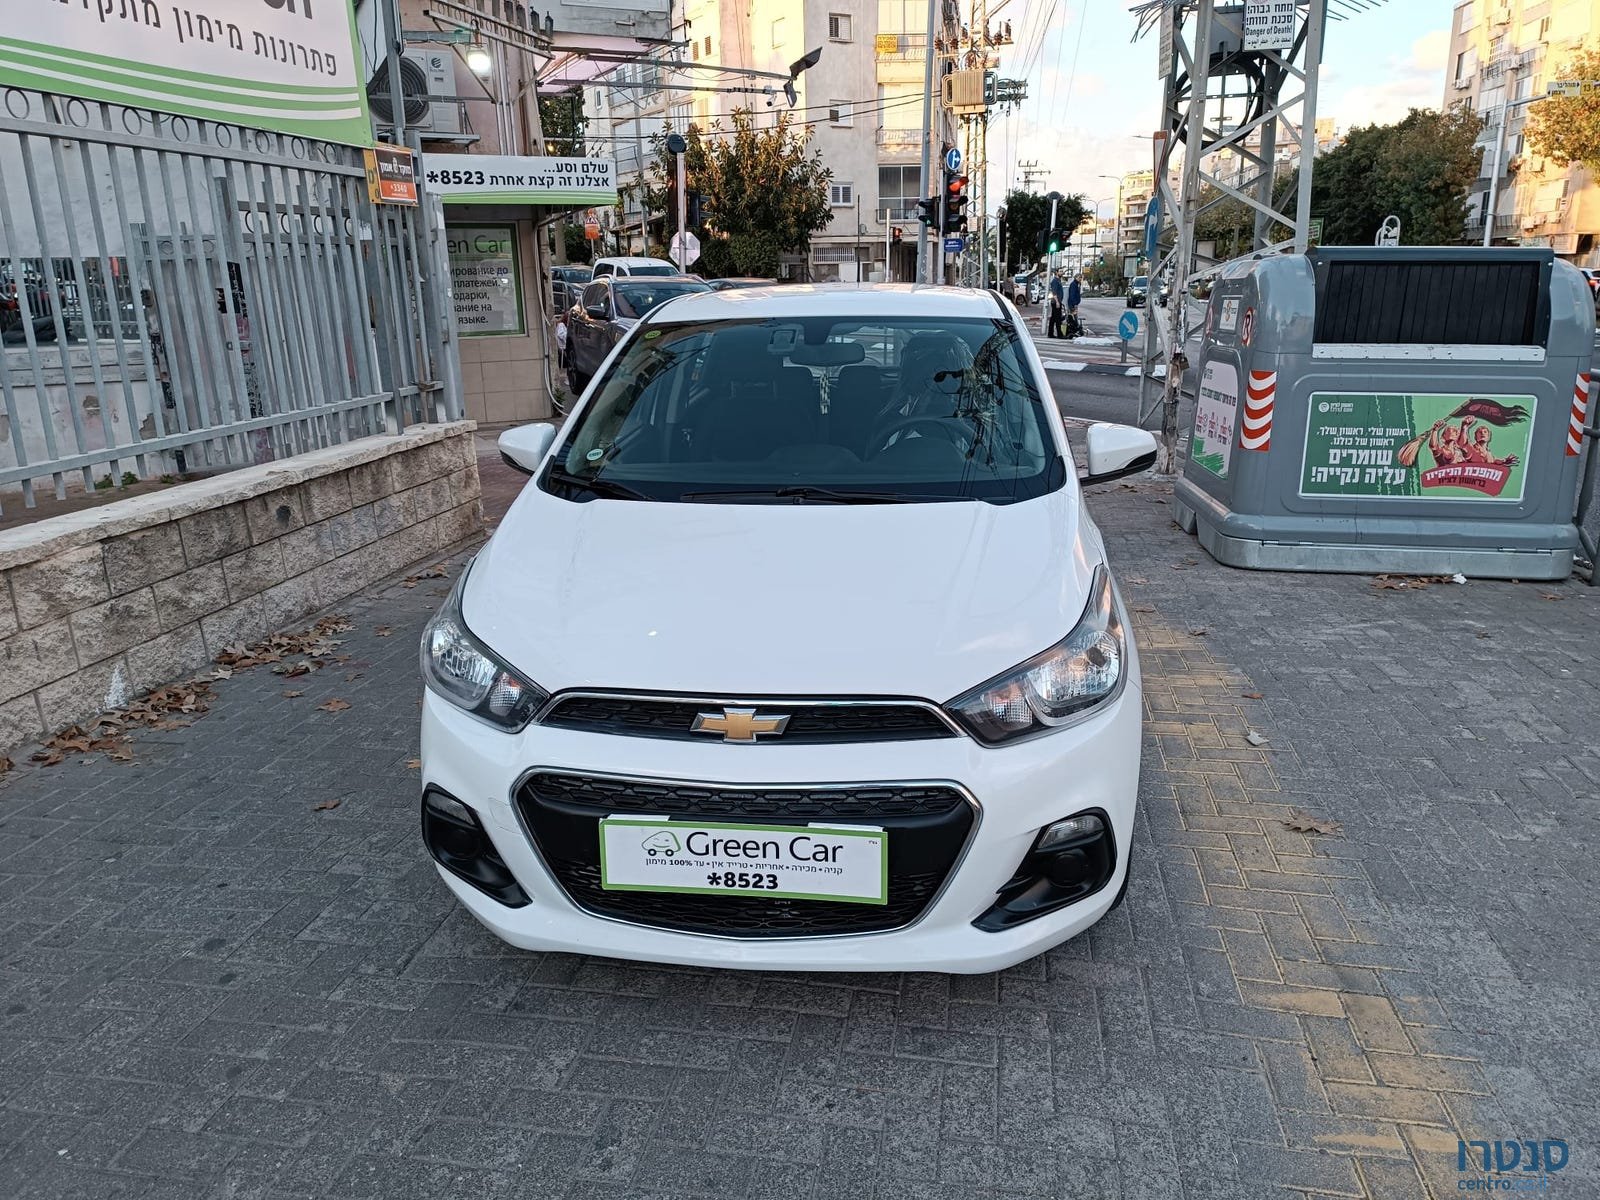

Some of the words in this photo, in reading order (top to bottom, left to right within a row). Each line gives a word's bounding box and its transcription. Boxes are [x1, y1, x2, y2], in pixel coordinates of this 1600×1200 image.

[1247, 4, 1271, 14] גבוה!
[1274, 3, 1293, 13] מתח
[1246, 16, 1268, 26] מוות!
[1271, 15, 1293, 24] סכנת
[172, 6, 243, 51] מימון
[1245, 27, 1266, 37] Danger
[1266, 26, 1273, 35] of
[1273, 25, 1293, 35] Death!
[252, 30, 338, 76] פתרונות
[1583, 84, 1591, 92] 13
[544, 162, 577, 173] וסע...
[581, 161, 609, 173] שלם
[489, 175, 524, 186] אחרת
[528, 175, 556, 189] קצת
[558, 175, 572, 187] זה
[576, 174, 610, 187] אצלנו
[447, 240, 470, 254] en
[474, 235, 508, 254] Car
[450, 266, 495, 277] ирование
[496, 266, 509, 277] до
[453, 277, 501, 287] платежей.
[453, 292, 490, 301] одарки,
[454, 303, 480, 312] ание
[480, 303, 493, 312] на
[457, 315, 489, 325] языке.
[1339, 427, 1364, 436] ראשון
[1385, 428, 1411, 437] ראשון
[1355, 436, 1368, 446] של
[1369, 437, 1394, 447] ראשון
[1328, 448, 1393, 465] שומרים
[1311, 466, 1360, 486] נקייה!
[1364, 466, 1406, 485] עליה
[1425, 466, 1462, 480] הניקיון
[1464, 466, 1503, 482] מהפכת
[1458, 478, 1487, 487] בראשון
[685, 831, 780, 860] Green
[788, 836, 844, 863] Car
[645, 858, 667, 866] מימון
[669, 859, 693, 867] 100%
[711, 860, 724, 869] אין
[725, 861, 748, 869] טרייד
[755, 862, 785, 871] אחריות
[791, 864, 817, 873] מכירה
[823, 866, 843, 875] קניה
